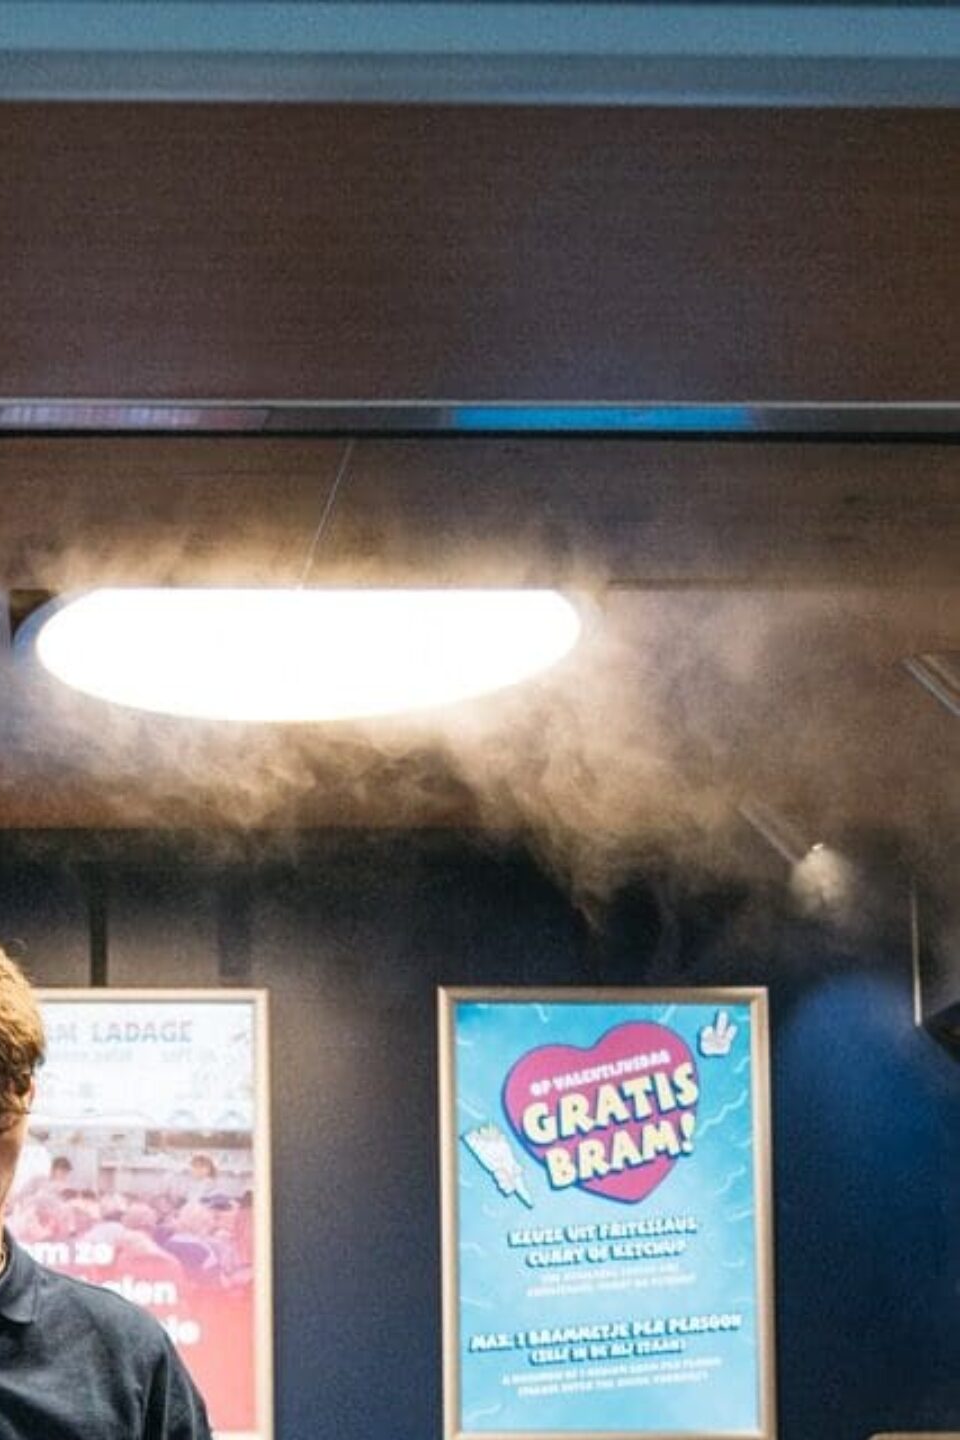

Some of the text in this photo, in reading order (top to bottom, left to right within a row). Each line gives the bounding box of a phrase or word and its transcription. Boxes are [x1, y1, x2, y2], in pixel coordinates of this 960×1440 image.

[92, 1020, 193, 1043] LADAGE
[522, 1062, 699, 1145] GRATIS
[544, 1112, 696, 1190] BRAM!
[610, 1239, 687, 1261] KETCHUP
